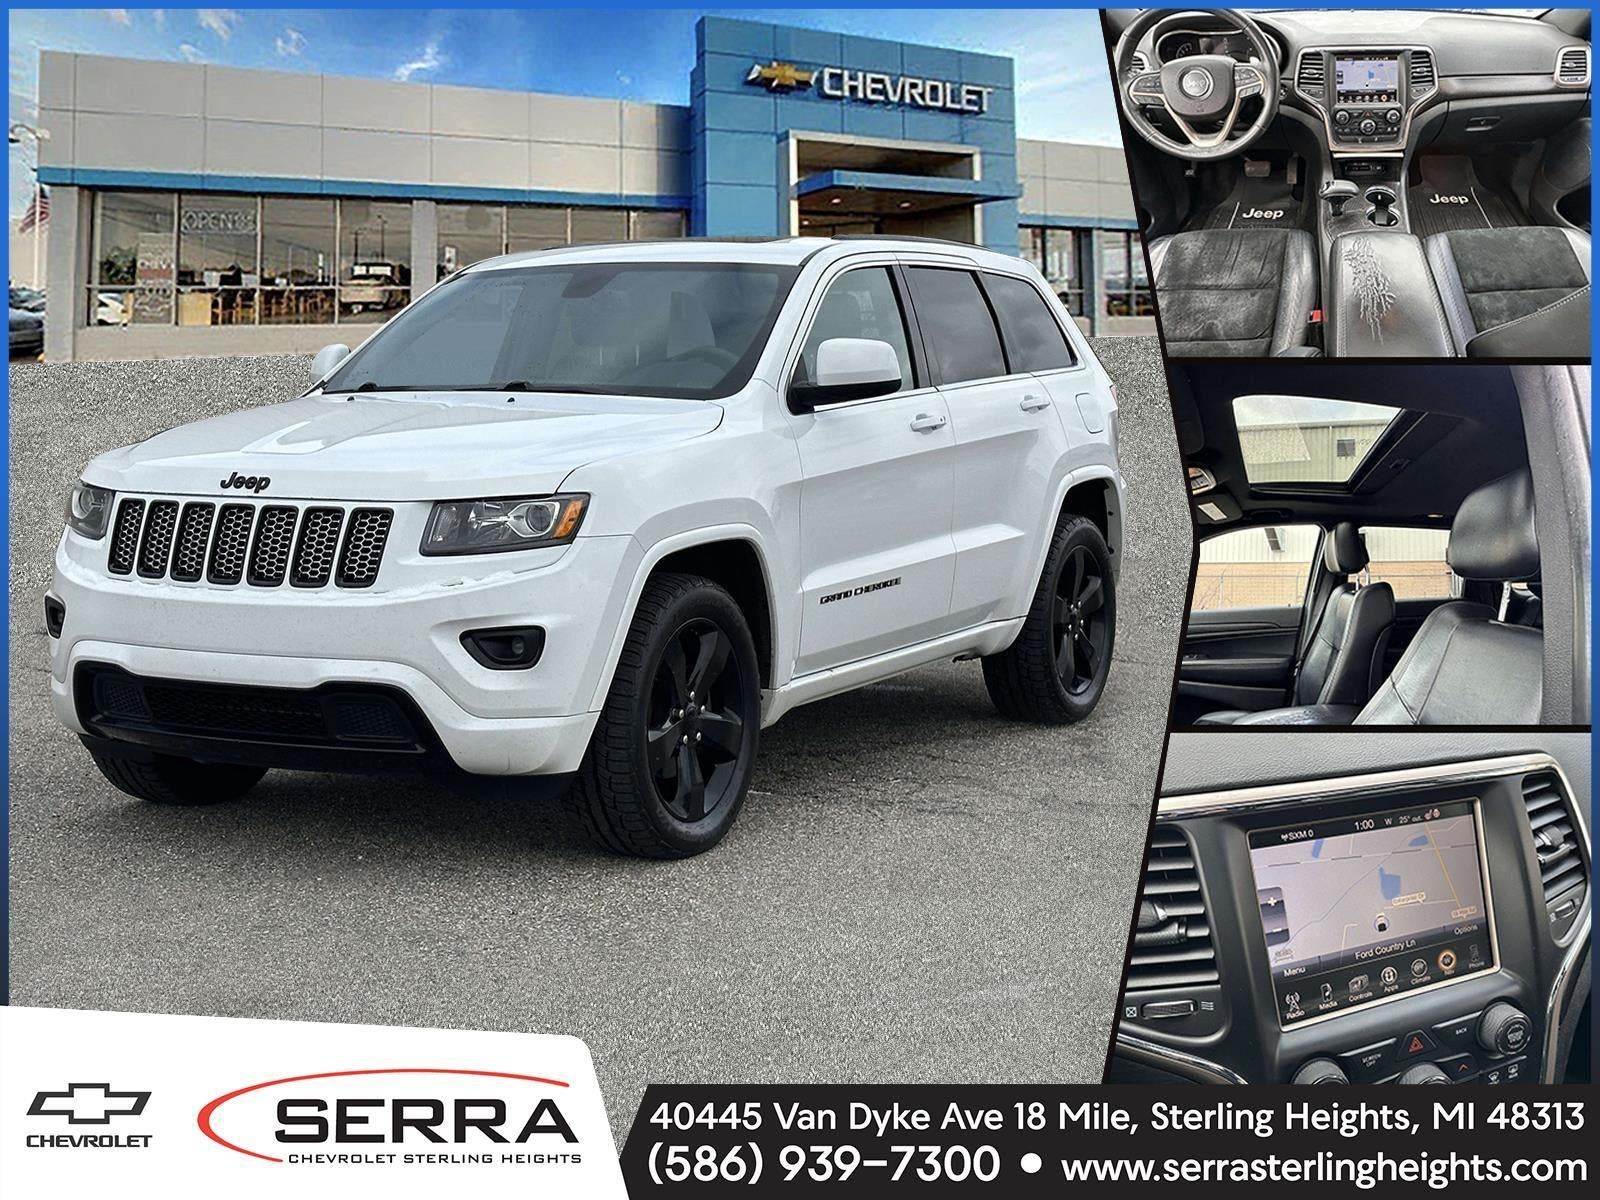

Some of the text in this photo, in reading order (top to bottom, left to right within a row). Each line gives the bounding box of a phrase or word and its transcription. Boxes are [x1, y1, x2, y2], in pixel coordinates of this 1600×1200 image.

[822, 66, 993, 112] CHEVROLET
[1430, 193, 1469, 205] Jeep
[1242, 208, 1284, 220] Jeep
[220, 471, 271, 494] Jeep
[820, 576, 902, 605] GRAND CHEROKEE
[1355, 817, 1376, 832] 1:00
[1384, 817, 1393, 826] W
[1288, 830, 1307, 841] SXM
[1454, 923, 1479, 936] Options
[1355, 939, 1417, 960] Ford Country Ln
[1283, 966, 1307, 977] Menu
[1319, 1000, 1339, 1011] Media
